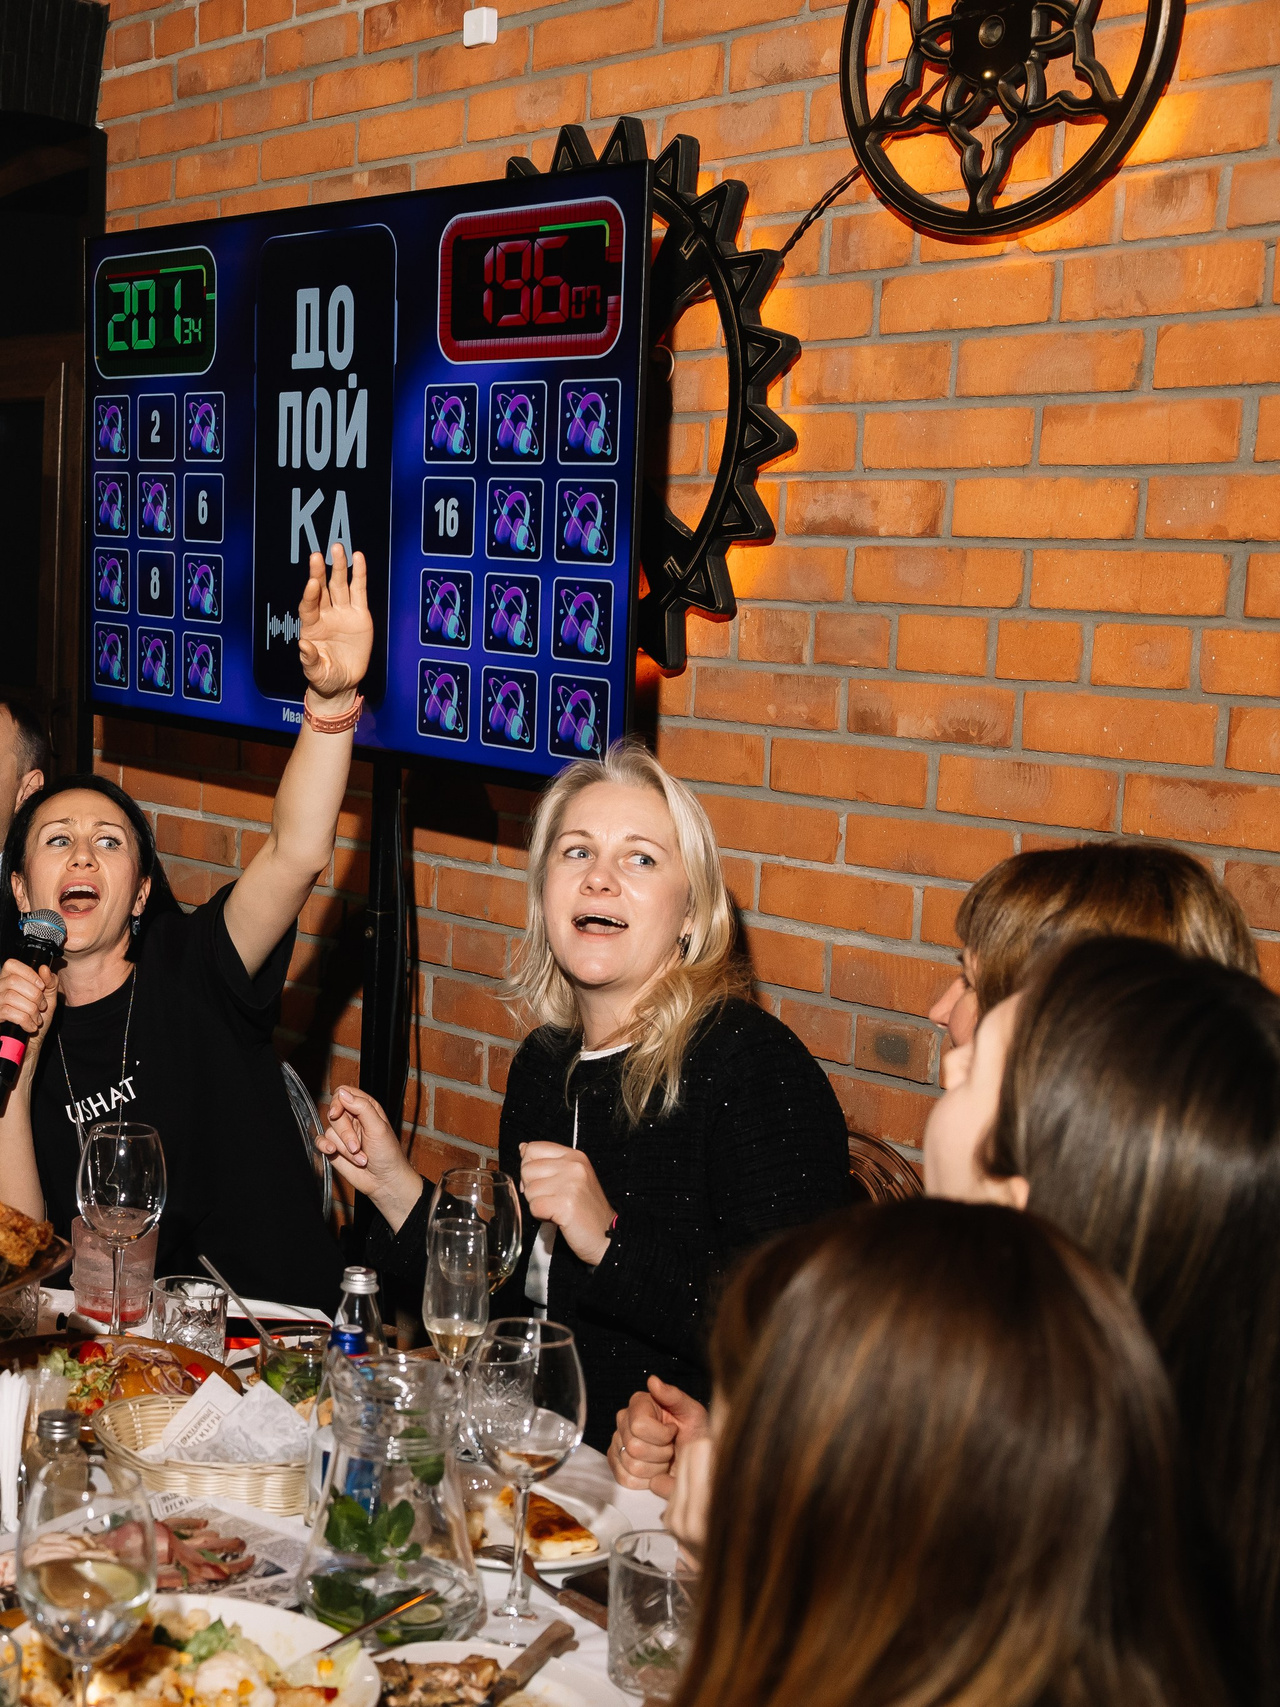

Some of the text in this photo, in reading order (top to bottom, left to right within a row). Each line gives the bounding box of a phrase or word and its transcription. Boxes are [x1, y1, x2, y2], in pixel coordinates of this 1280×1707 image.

[483, 236, 601, 326] 196 07
[107, 279, 202, 351] 201 34
[291, 285, 354, 371] ДО
[150, 410, 161, 443] 2
[278, 373, 368, 471] ПОЙ
[197, 490, 208, 525] 6
[290, 487, 353, 567] КА
[434, 497, 459, 538] 16
[150, 567, 161, 600] 8
[65, 1060, 140, 1124] USHAT
[188, 1413, 222, 1447] РЕМЬЕРЫ
